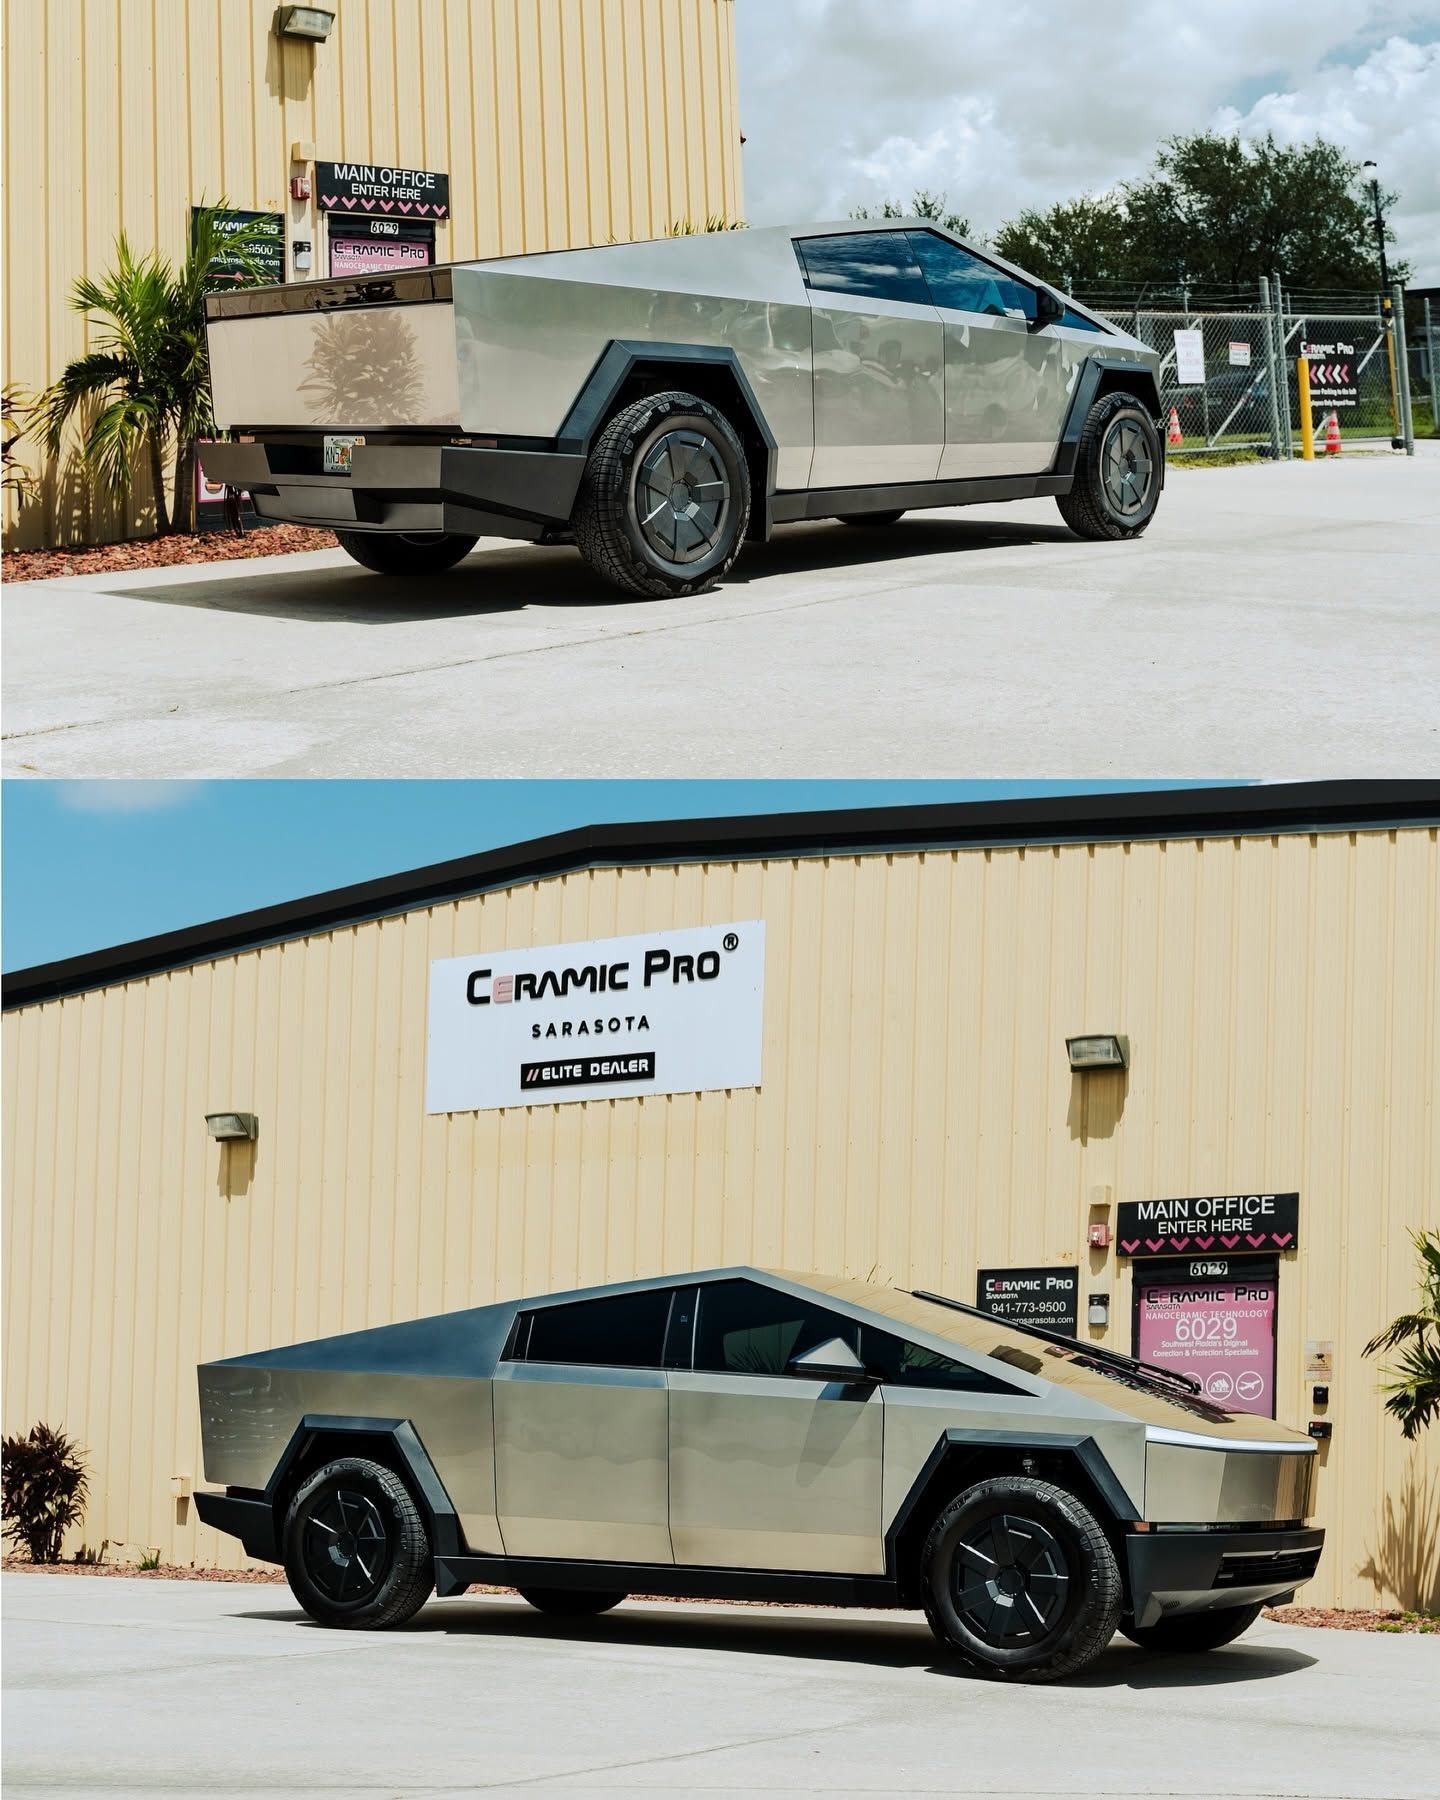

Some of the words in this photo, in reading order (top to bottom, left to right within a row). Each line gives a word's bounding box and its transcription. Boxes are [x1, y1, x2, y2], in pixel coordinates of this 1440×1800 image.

[334, 164, 375, 183] MAIN
[380, 168, 435, 189] OFFICE
[351, 183, 389, 197] ENTER
[391, 187, 421, 200] HERE
[371, 221, 398, 234] 6029
[334, 241, 395, 257] CERAMIC
[400, 245, 425, 259] PRO
[466, 962, 630, 1005] CERAMIC
[531, 1015, 650, 1039] SARASOTA
[590, 1058, 649, 1076] DEALER
[1137, 1199, 1189, 1220] MAIN
[1194, 1196, 1275, 1217] OFFICE
[1158, 1219, 1207, 1235] ENTER
[1211, 1217, 1253, 1232] HERE
[1190, 1262, 1228, 1276] 6029
[985, 1279, 1041, 1292] CERAMIC
[1045, 1277, 1074, 1290] PRO
[985, 1292, 1019, 1300] SARASOTA
[1146, 1289, 1226, 1304] CERAMIC
[1234, 1286, 1269, 1301] PRO
[991, 1301, 1067, 1314] 941-773-9500
[1145, 1310, 1208, 1321] NANOCERAMIC
[1210, 1309, 1268, 1319] TECHNOLOGY
[1175, 1318, 1238, 1341] 6029
